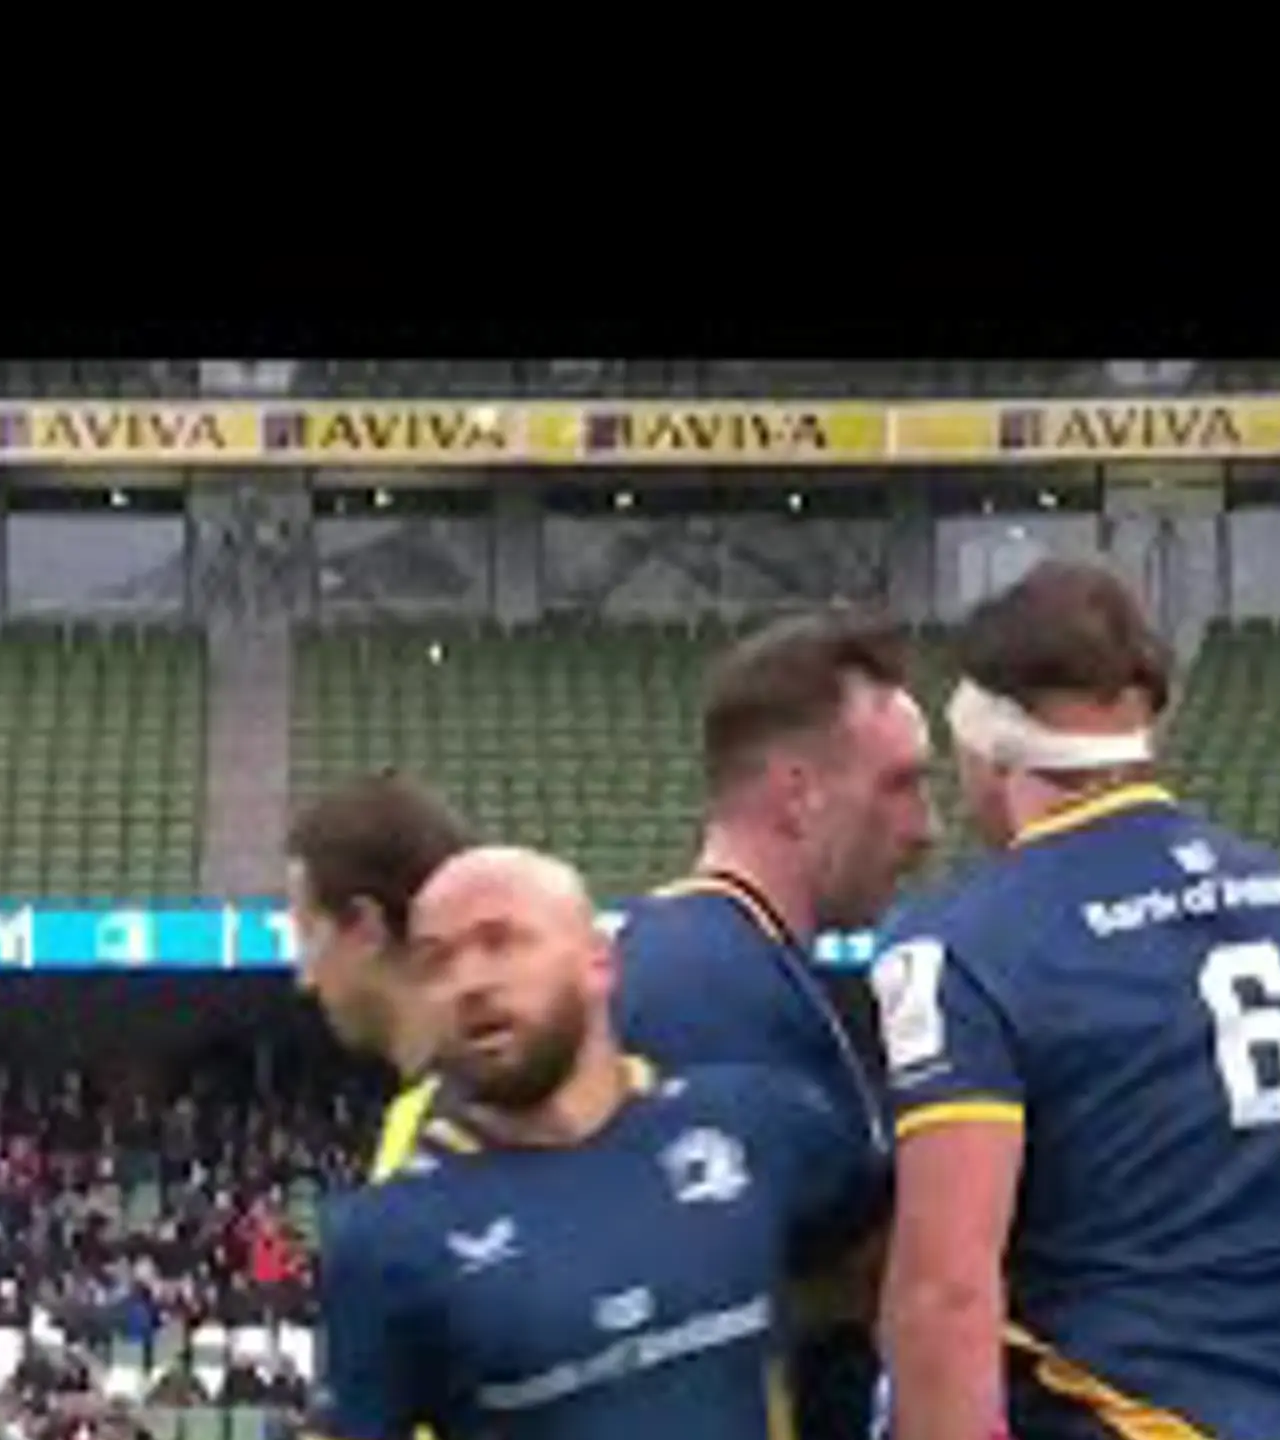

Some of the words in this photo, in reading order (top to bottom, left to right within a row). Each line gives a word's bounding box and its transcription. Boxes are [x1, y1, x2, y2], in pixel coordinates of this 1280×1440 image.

[42, 411, 227, 449] AVIVA
[320, 410, 507, 449] AVIVA
[640, 411, 830, 450] AVIVA
[1054, 407, 1242, 449] AVIVA
